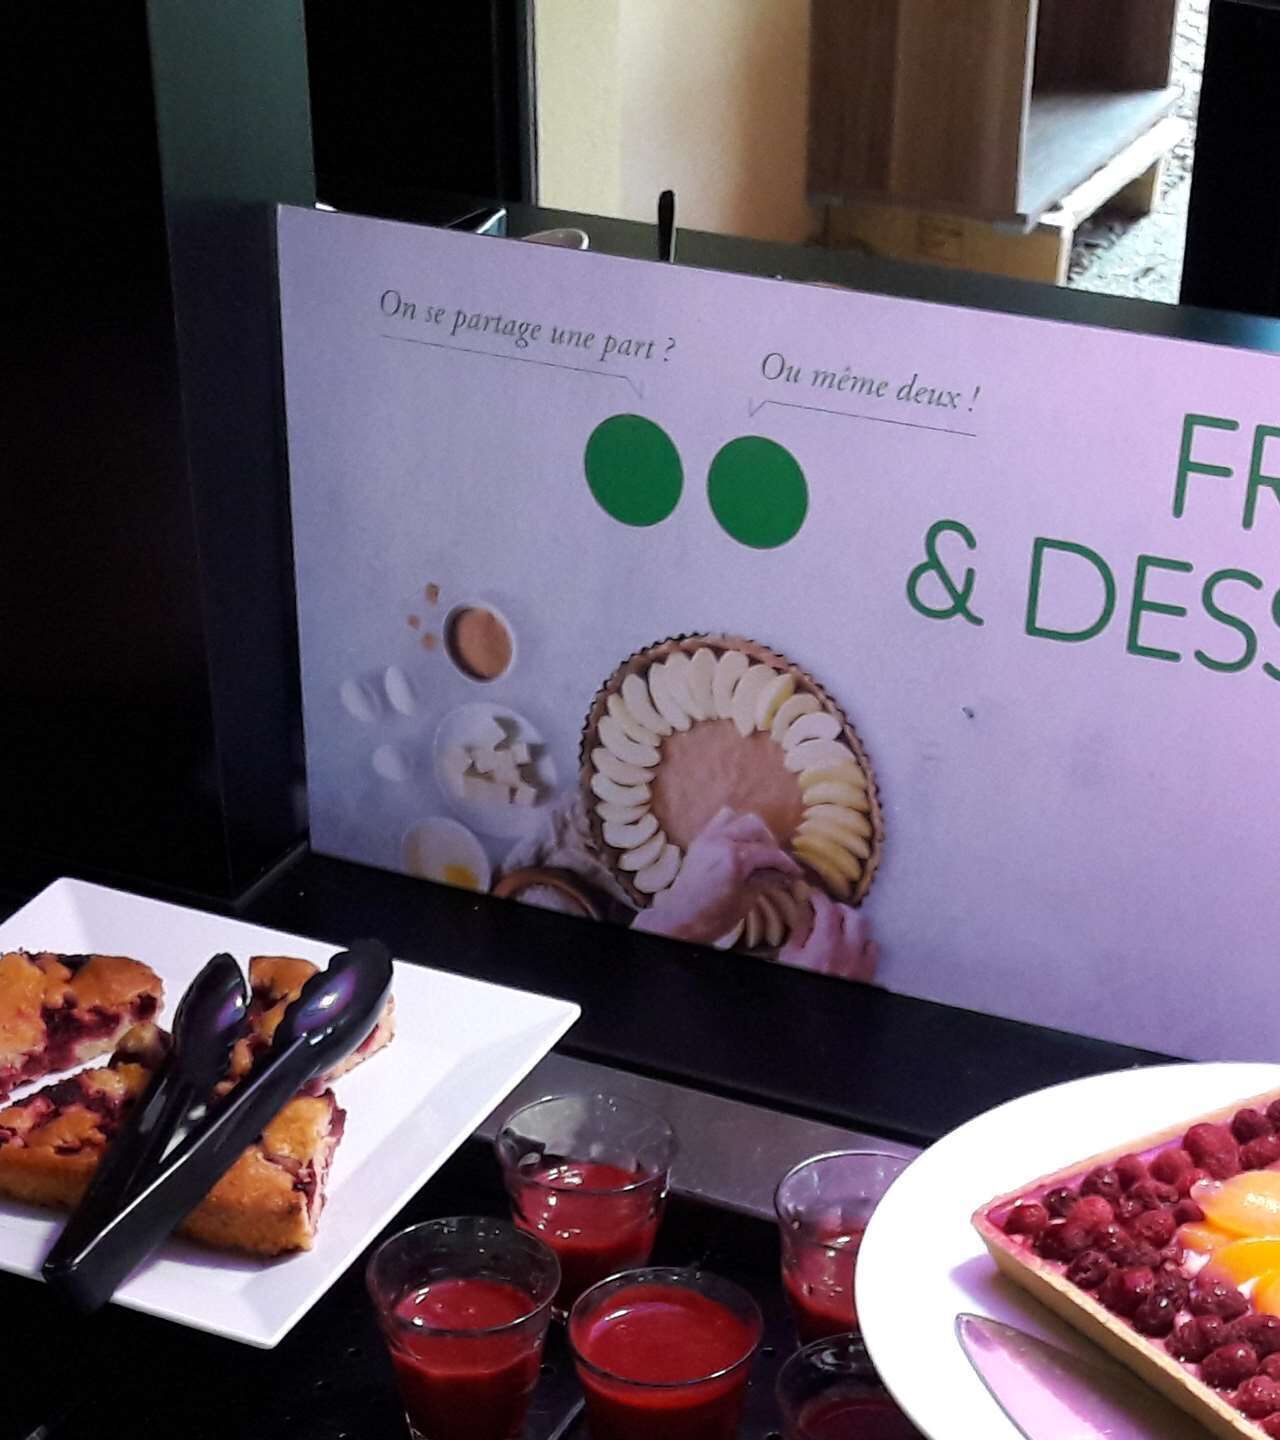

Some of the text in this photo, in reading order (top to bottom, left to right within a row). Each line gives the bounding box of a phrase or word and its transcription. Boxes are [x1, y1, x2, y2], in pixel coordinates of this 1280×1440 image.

[379, 289, 677, 363] On se partage une part ?
[761, 352, 981, 413] Ou même deux !
[905, 519, 984, 626] &
